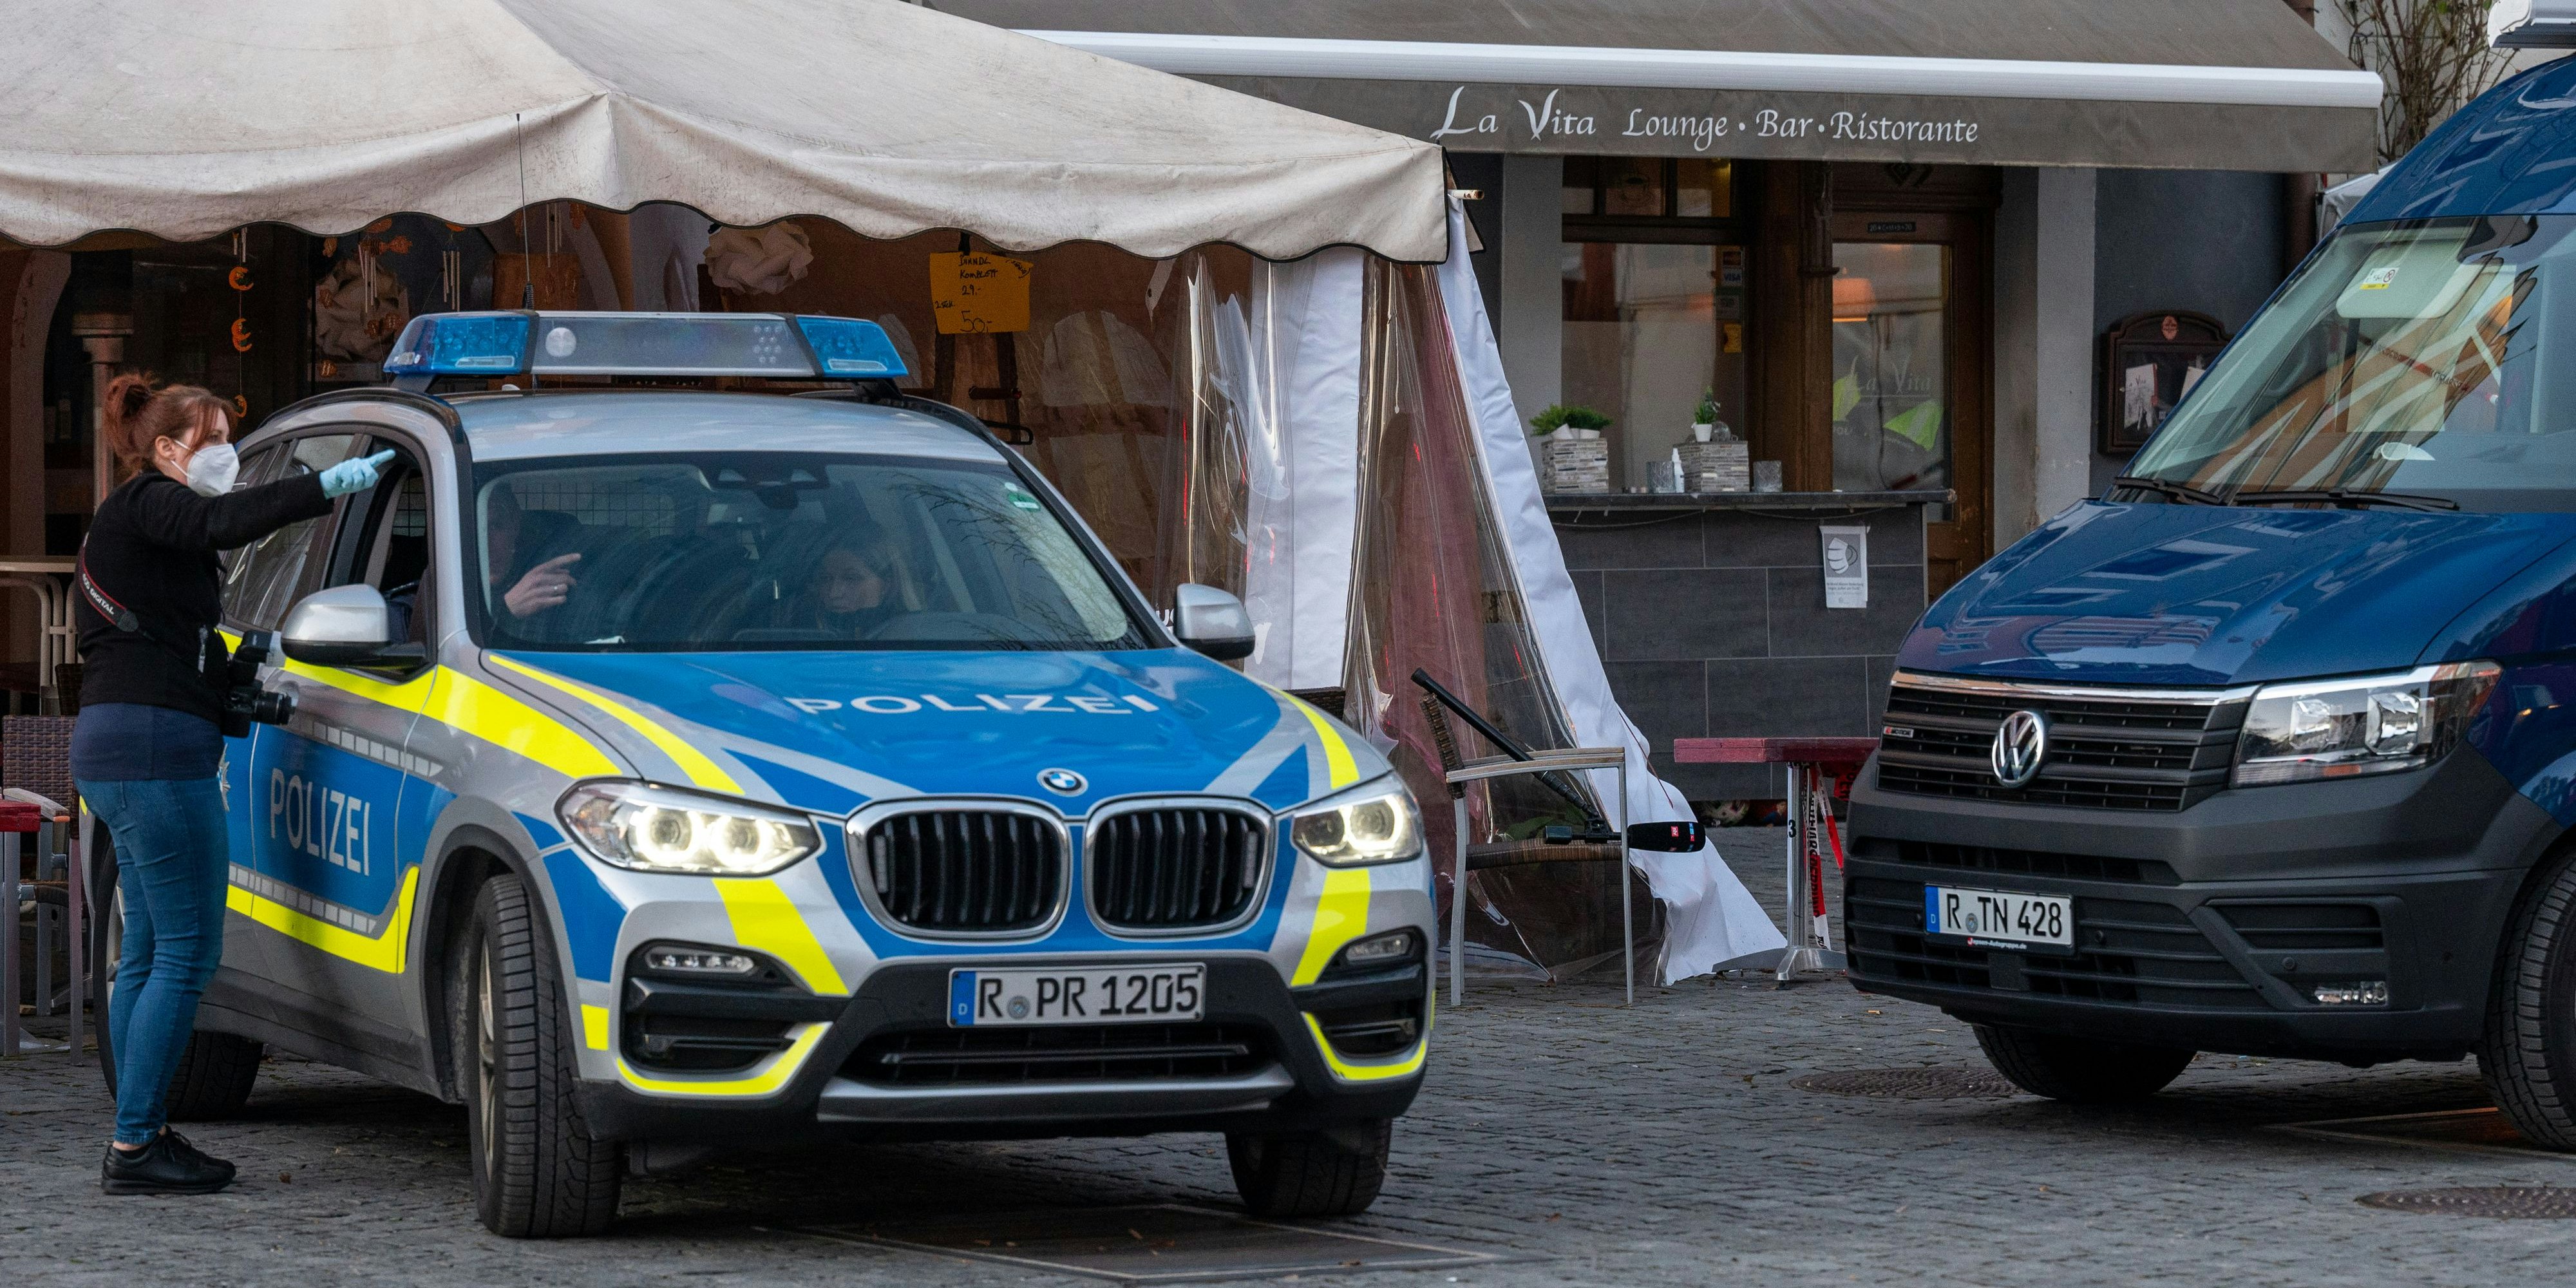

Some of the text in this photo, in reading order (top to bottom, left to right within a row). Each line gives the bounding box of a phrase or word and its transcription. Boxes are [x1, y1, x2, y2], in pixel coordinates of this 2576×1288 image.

[1429, 86, 1979, 151] La Vita Lounge Bar Ristorante
[1724, 272, 1741, 281] VISA
[90, 587, 115, 616] DIGITAL
[784, 694, 1160, 716] POLIZEI
[269, 768, 371, 876] POLIZEI
[1788, 819, 1797, 838] 3
[1947, 893, 1961, 929] R
[1978, 896, 2008, 933] TN
[2018, 900, 2062, 938] 428
[958, 973, 1199, 1018] D R PR 1205
